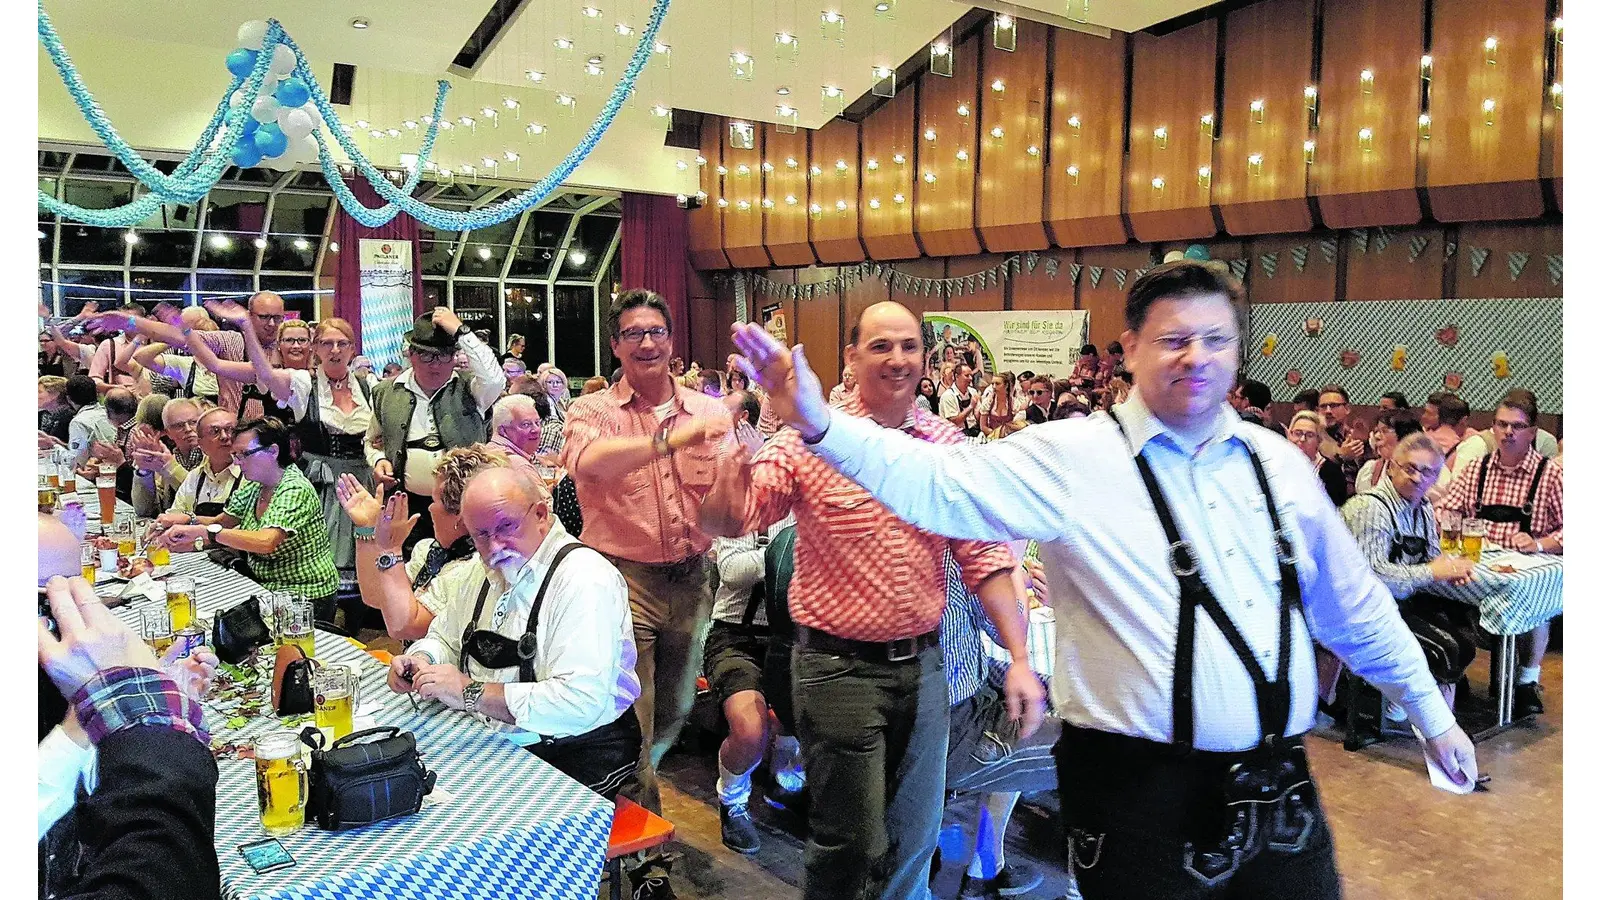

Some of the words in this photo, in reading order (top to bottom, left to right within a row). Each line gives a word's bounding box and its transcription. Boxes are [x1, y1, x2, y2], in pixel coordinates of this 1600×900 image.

[1003, 320, 1014, 329] Wir
[1016, 320, 1030, 330] sind
[1031, 320, 1041, 330] für
[1042, 320, 1054, 329] Sie
[1054, 320, 1063, 329] da
